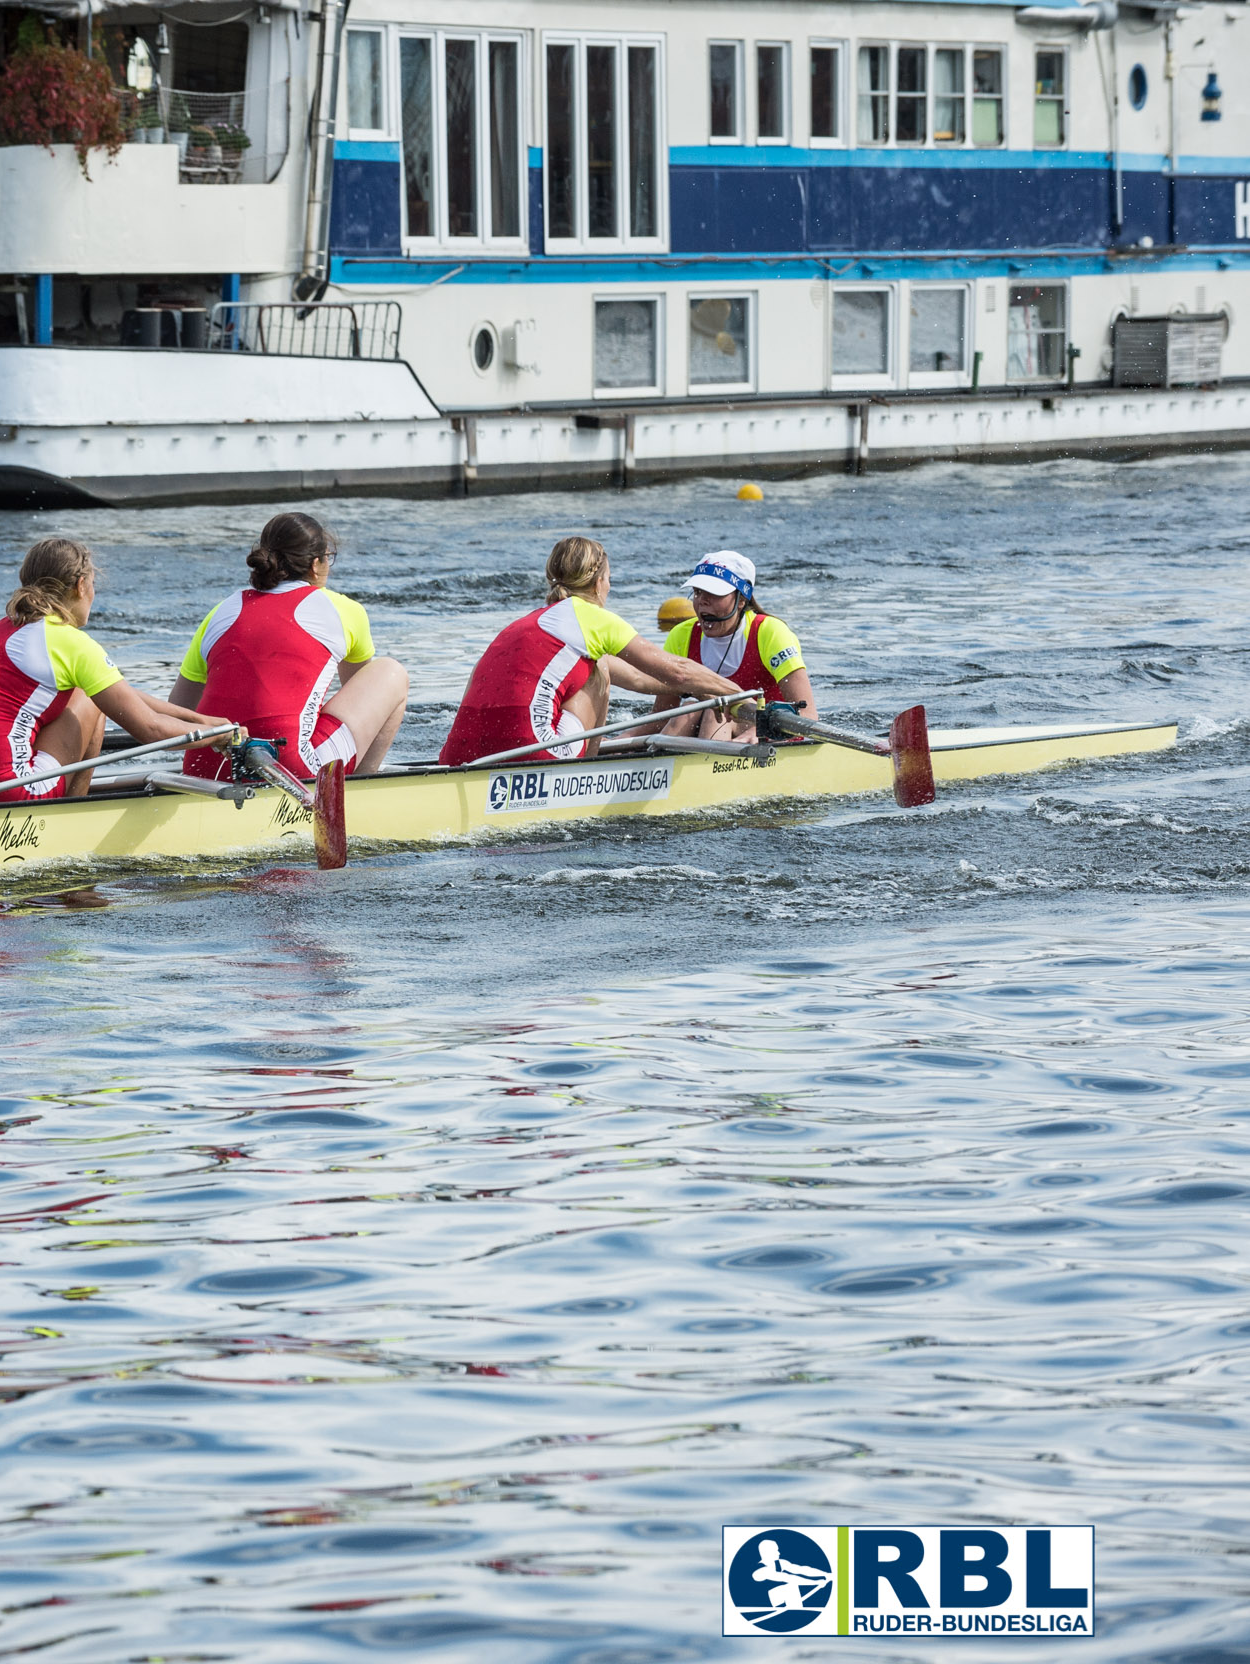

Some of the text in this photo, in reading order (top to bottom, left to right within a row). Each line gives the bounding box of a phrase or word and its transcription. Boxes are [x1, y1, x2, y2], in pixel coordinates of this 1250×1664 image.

[713, 567, 725, 577] NK
[510, 769, 668, 801] RBL RUDER-BUNDESLIGA
